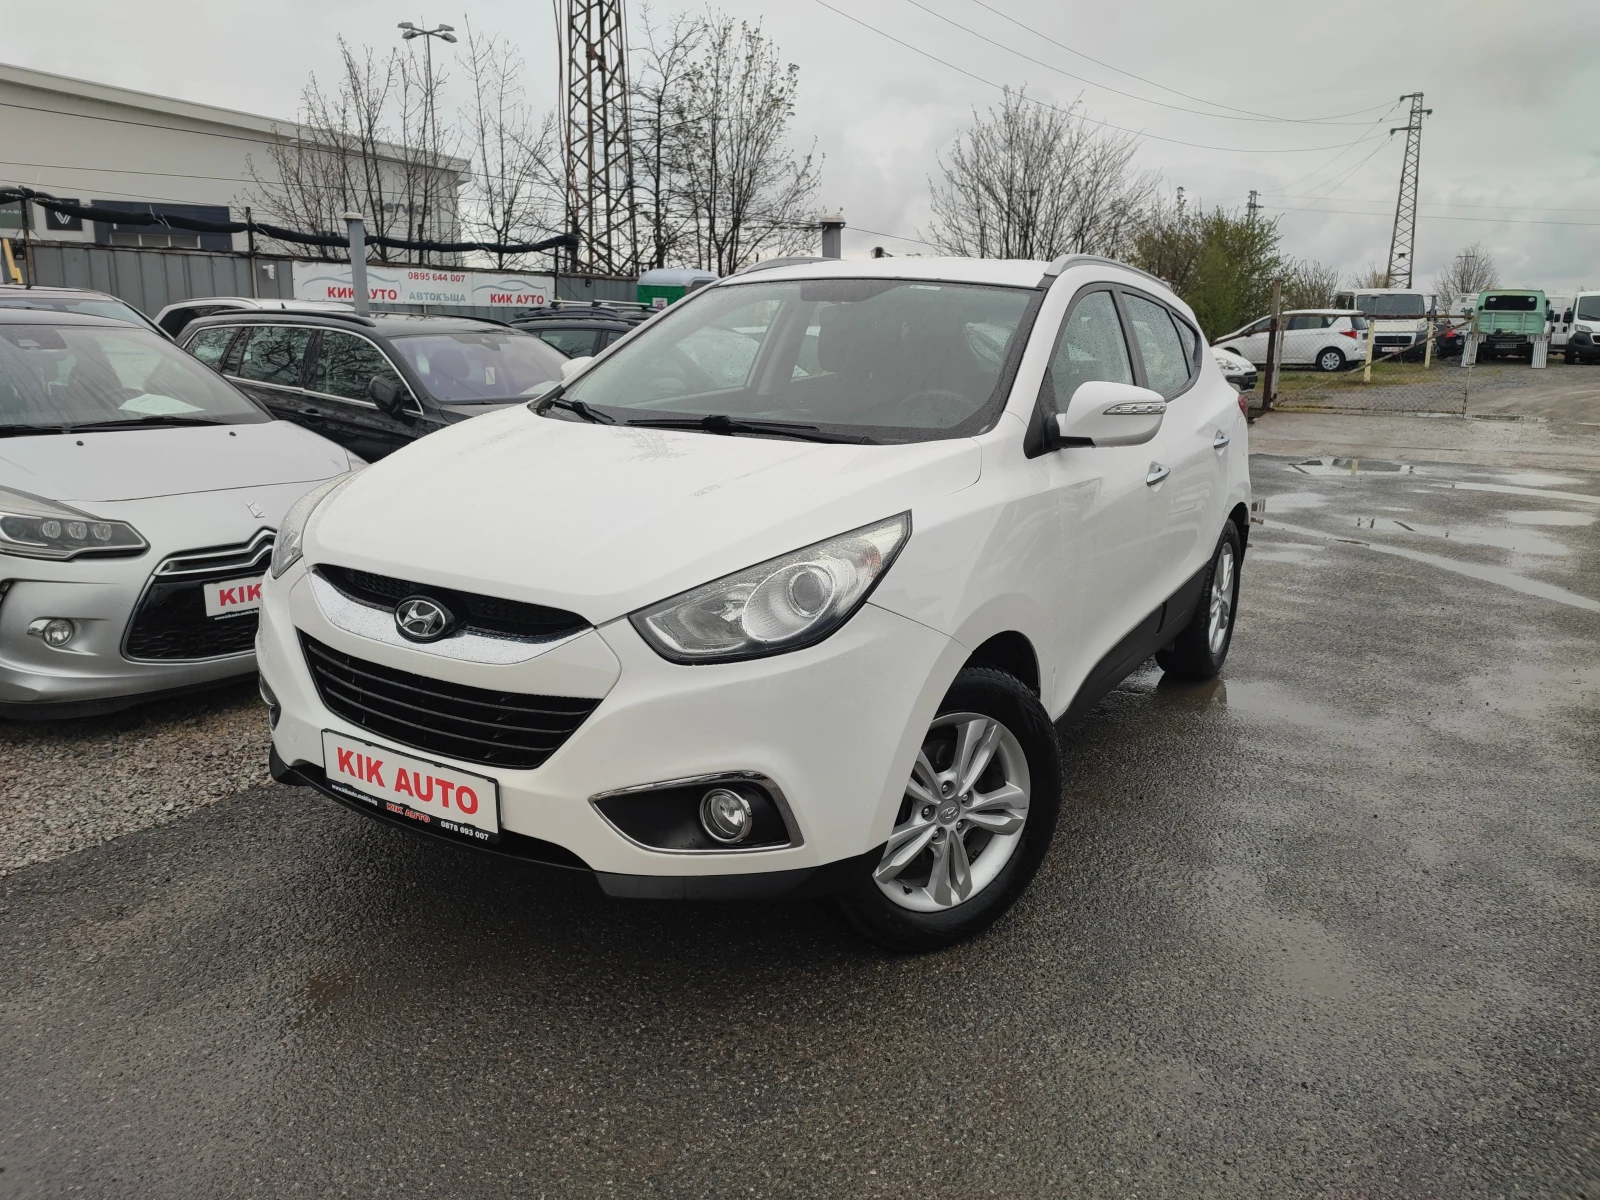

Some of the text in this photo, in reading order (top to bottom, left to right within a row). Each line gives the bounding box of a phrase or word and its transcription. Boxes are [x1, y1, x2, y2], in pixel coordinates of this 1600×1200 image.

[408, 271, 466, 282] 0895 644 007
[367, 288, 398, 301] УТО
[409, 291, 467, 303] АВТОКЪЩА
[490, 293, 545, 305] КИК АУТО
[219, 583, 262, 606] KIK
[337, 747, 478, 815] KIK AUTO
[386, 802, 430, 823] KIK AUTO
[440, 820, 459, 832] 0878
[474, 831, 490, 841] 007
